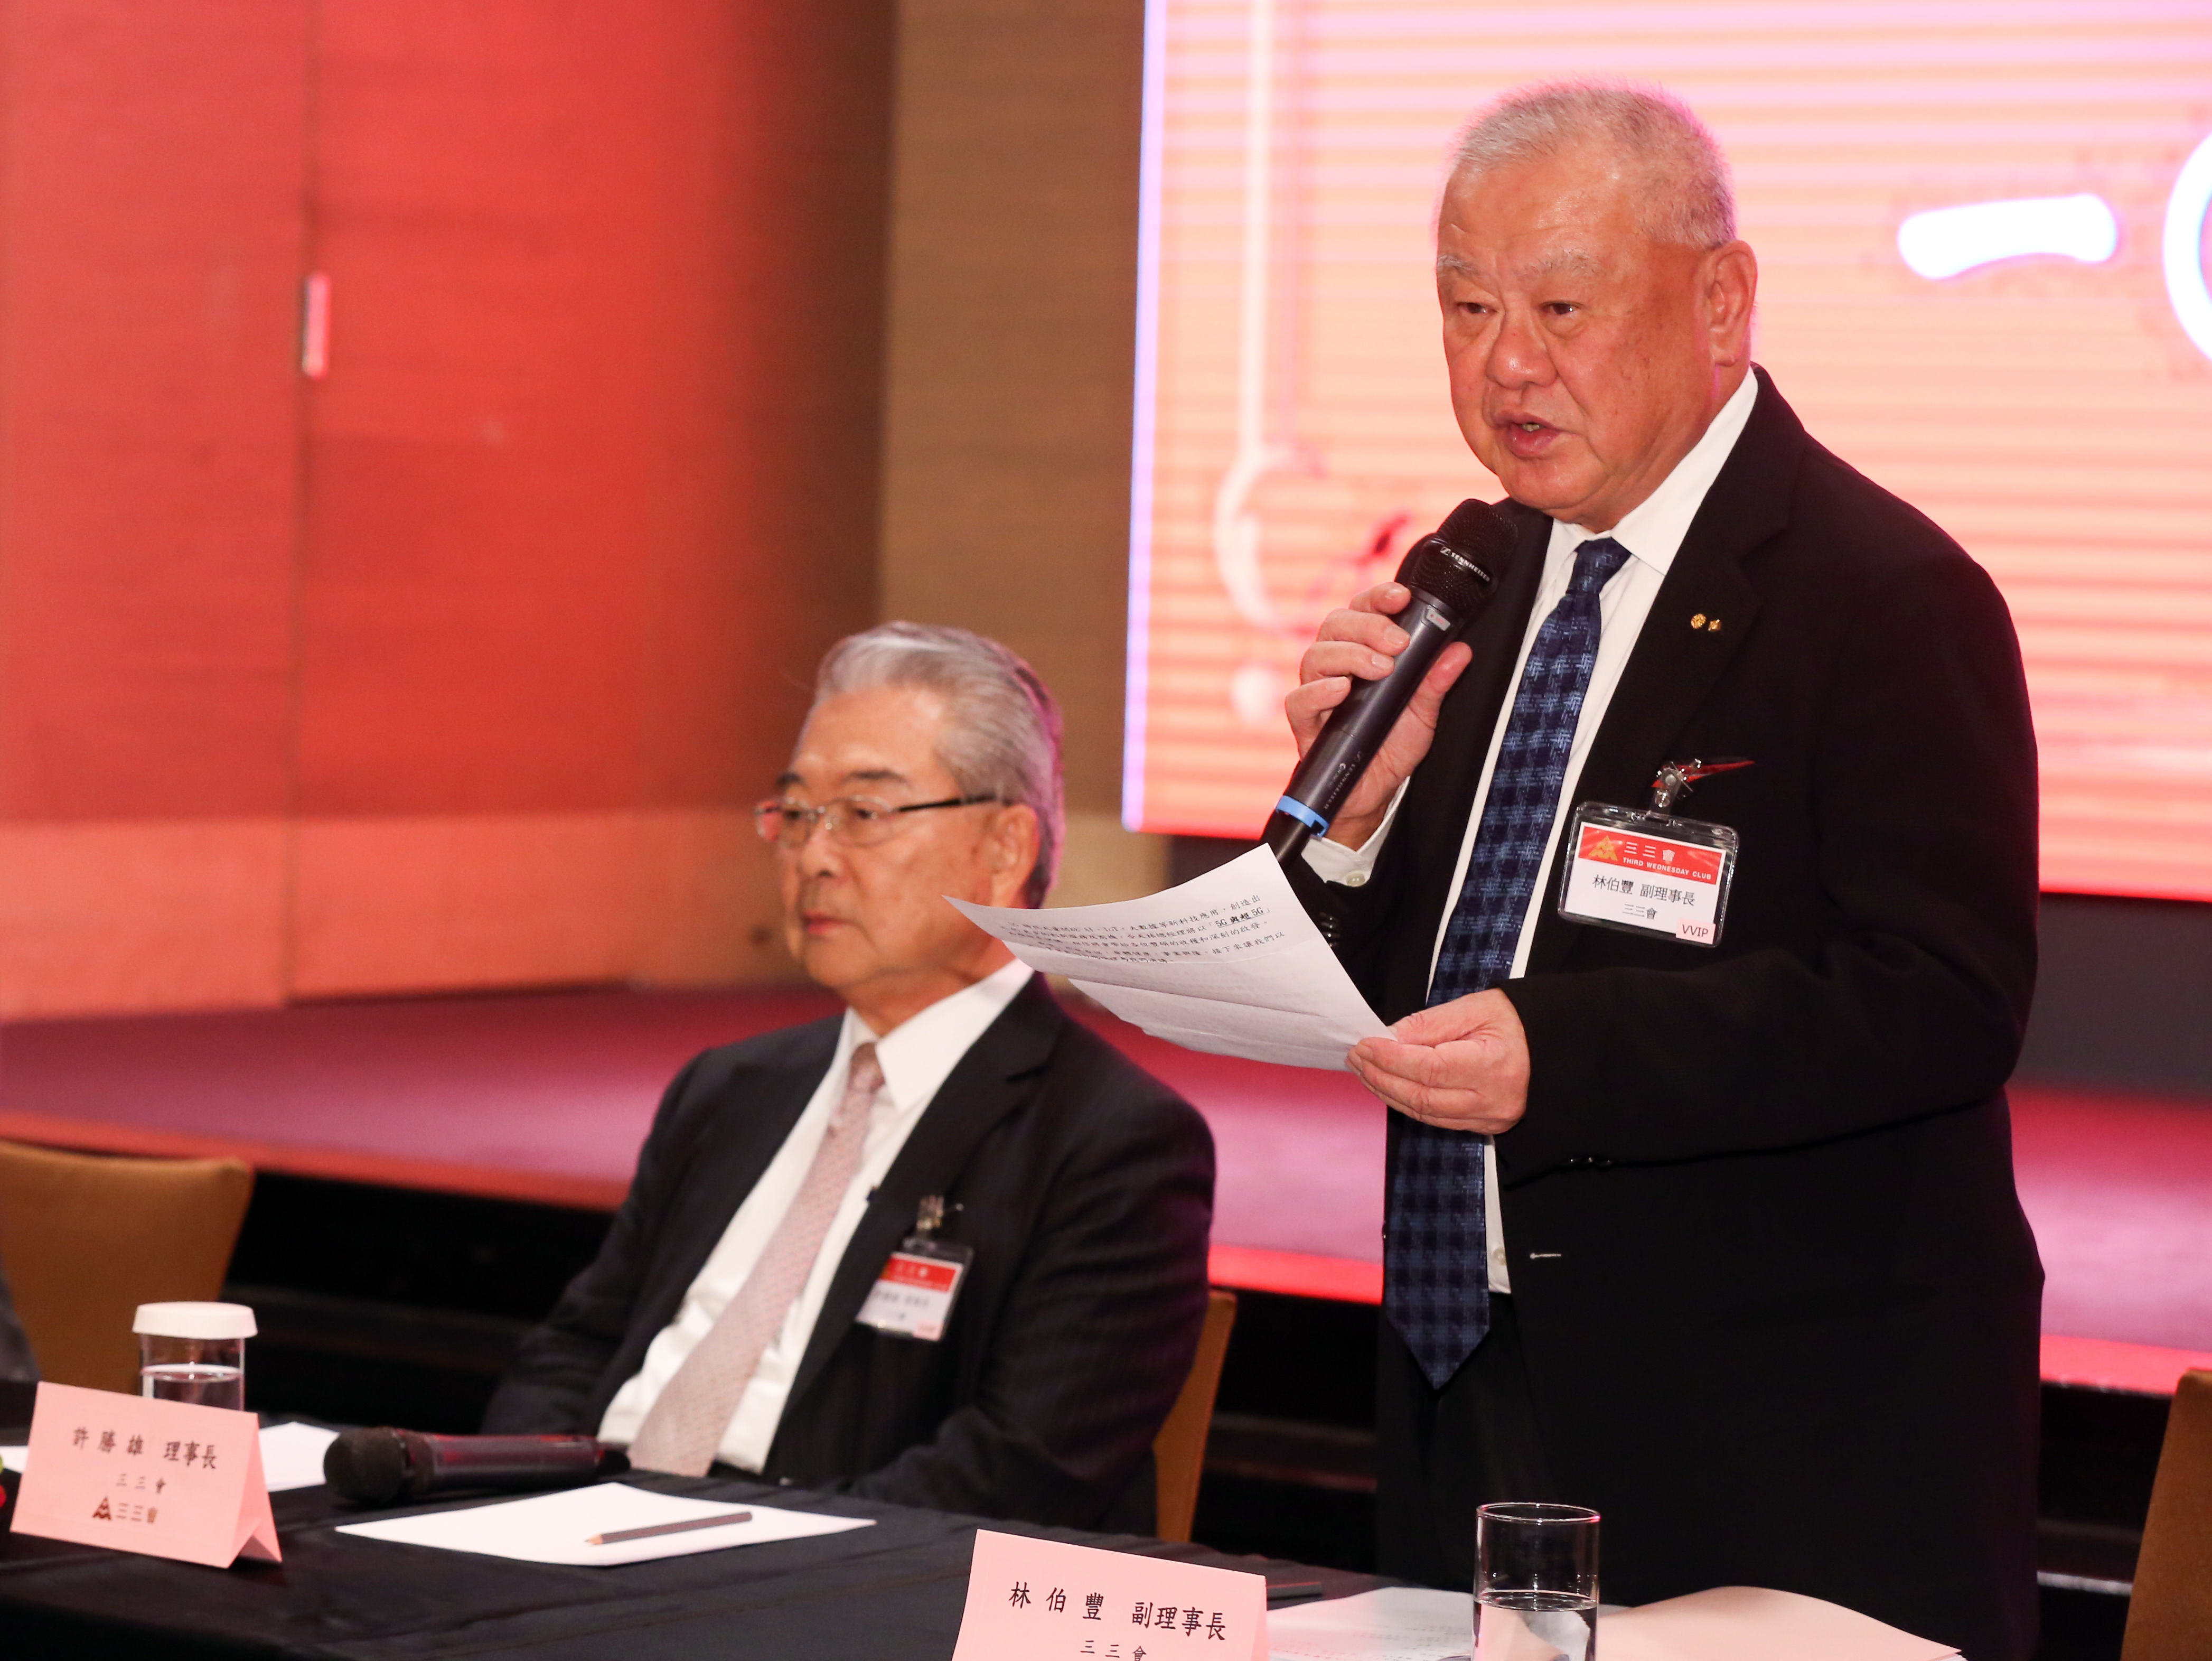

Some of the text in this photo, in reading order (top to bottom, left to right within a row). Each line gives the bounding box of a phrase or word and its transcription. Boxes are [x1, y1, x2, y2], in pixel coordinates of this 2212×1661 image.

[1451, 551, 1491, 582] SENNHEISER
[1623, 857, 1711, 880] THIRD WEDNESDAY CLUB
[1592, 874, 1695, 907] 林伯豐 副理事長
[1622, 903, 1657, 920] 三三會
[1682, 923, 1709, 937] VVIP
[73, 1427, 217, 1469] 許勝雄 理事長
[1008, 1581, 1226, 1641] 林伯豐 副理事長
[1080, 1640, 1147, 1661] 三三會
